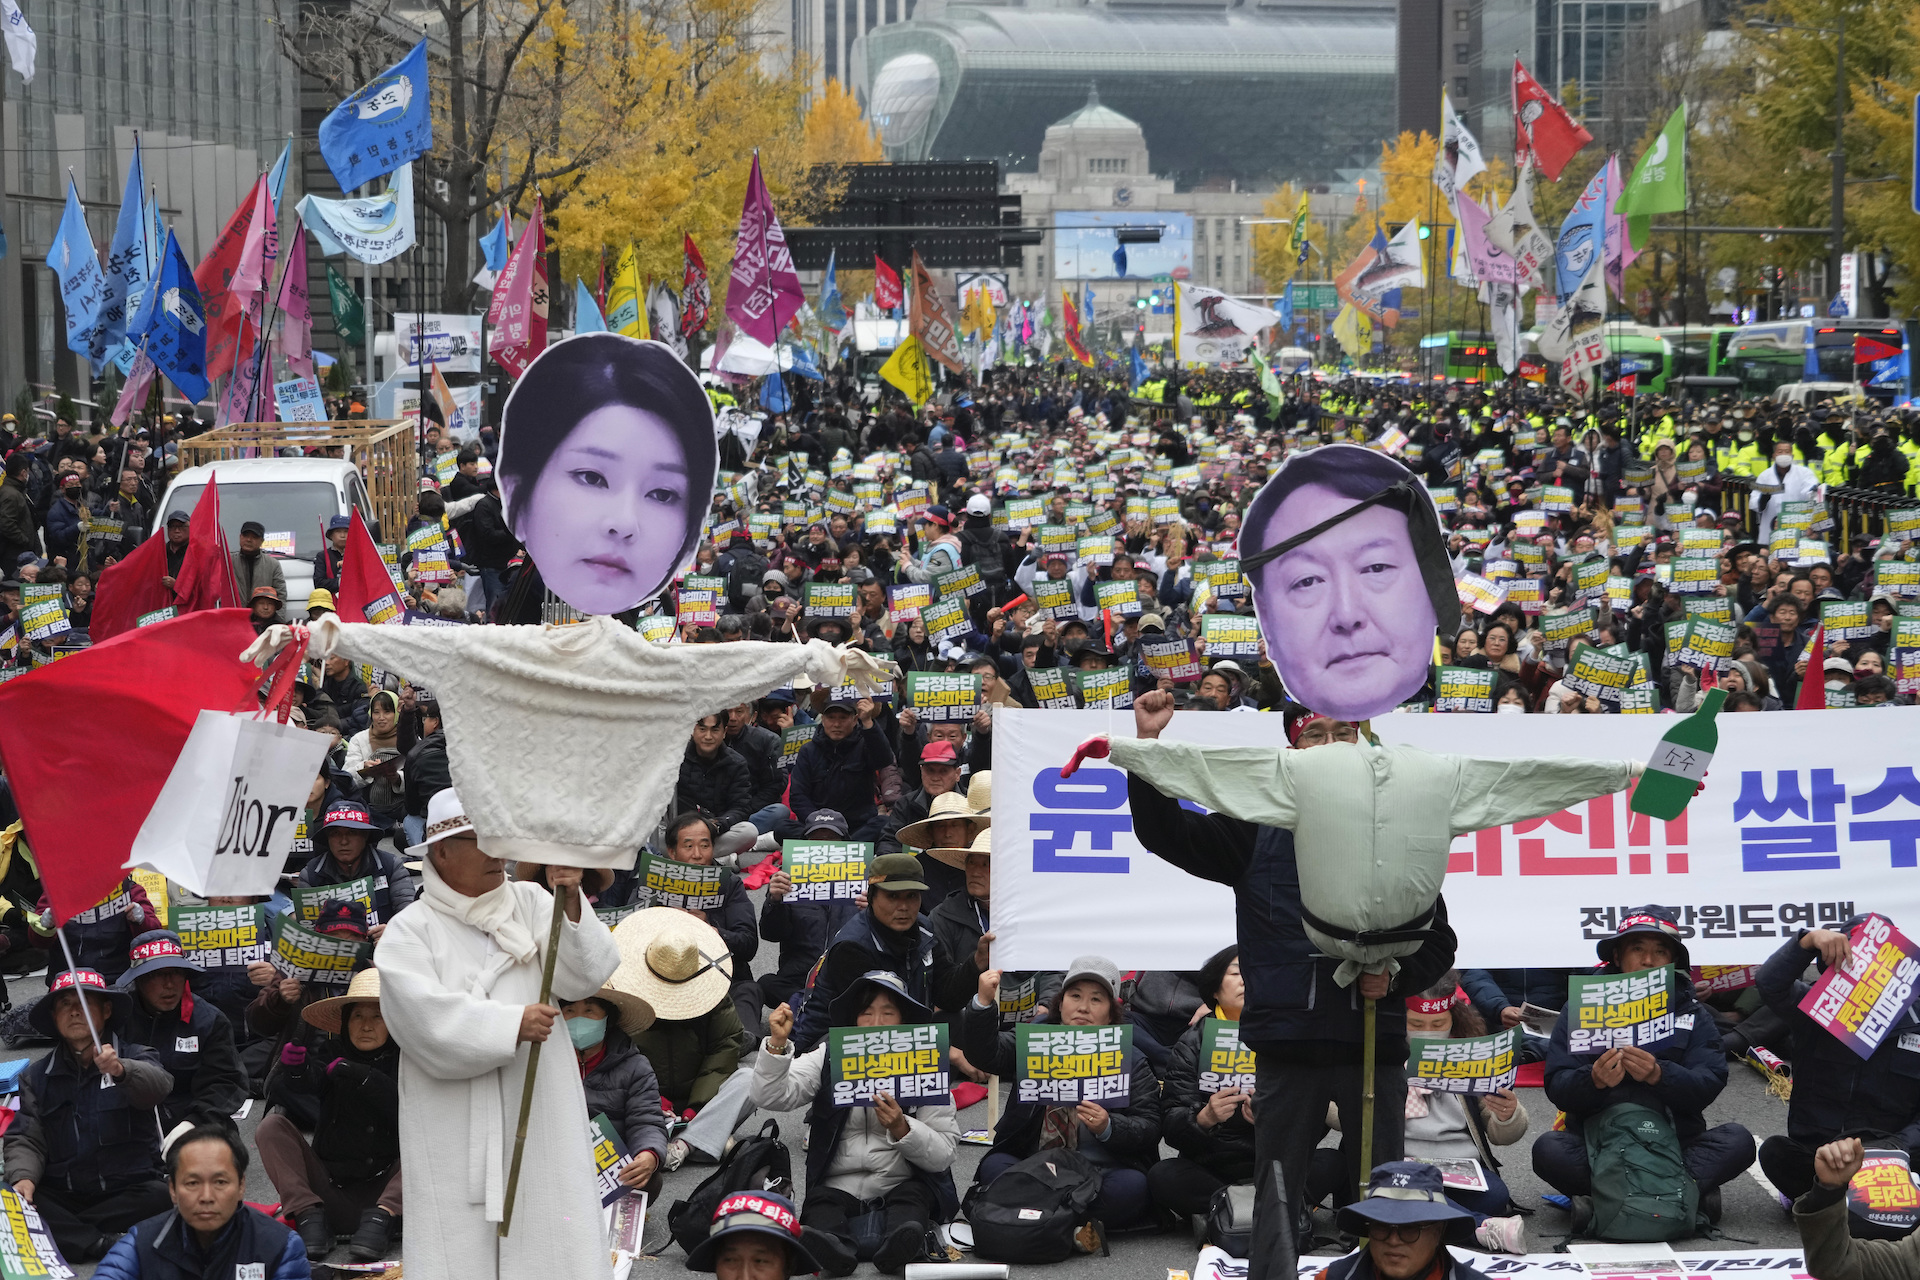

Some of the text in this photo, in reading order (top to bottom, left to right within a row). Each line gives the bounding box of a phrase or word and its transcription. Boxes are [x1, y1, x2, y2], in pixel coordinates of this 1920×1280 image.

[409, 523, 441, 545] 국정농단
[1079, 537, 1112, 549] 국정농단
[1682, 529, 1723, 542] 국정농단
[418, 551, 447, 562] 농업파괴
[1079, 545, 1113, 557] 민생파탄
[418, 560, 449, 572] 농민말살
[937, 565, 977, 585] 국정농단
[1485, 561, 1518, 573] 농업파괴
[1675, 558, 1719, 572] 국정농단
[688, 577, 724, 588] 국정농단
[940, 574, 980, 595] 민생파탄
[1461, 574, 1505, 597] 농업파괴
[1499, 579, 1540, 591] 농업파괴
[1669, 580, 1721, 593] 윤석열 퇴진!
[1674, 569, 1719, 583] 민생파탄
[25, 583, 63, 597] 국정농단
[679, 590, 713, 602] 농업파괴
[810, 585, 853, 597] 국정농단
[892, 584, 930, 600] 농업파괴
[965, 580, 987, 597] 퇴진!
[1034, 580, 1068, 595] 국정농단
[1098, 581, 1137, 599] 국정농단
[1219, 582, 1243, 596] 퇴진!
[1457, 580, 1500, 604] 농민말살
[22, 599, 60, 621] 국정농단
[679, 600, 712, 613] 농민말살
[804, 606, 857, 617] 윤석열 퇴진!
[809, 595, 853, 607] 민생파탄
[893, 595, 931, 611] 농민말살
[924, 599, 961, 622] 국정농단
[1099, 591, 1138, 611] 민생파탄
[1122, 599, 1142, 615] 퇴진!
[1520, 600, 1545, 611] 퇴진!
[1685, 598, 1730, 614] 국정농단
[1824, 602, 1867, 618] 국정농단
[23, 610, 64, 634] 민생파탄
[694, 611, 715, 623] 퇴진!
[890, 608, 919, 623] 윤석열
[926, 611, 965, 635] 민생파탄
[1054, 604, 1079, 621] 퇴진!
[1545, 610, 1592, 632] 국정농단
[1823, 614, 1868, 629] 민생파탄
[50, 619, 71, 635] 퇴진!
[948, 621, 972, 641] 퇴진!
[1208, 617, 1258, 630] 국정농단
[1545, 619, 1594, 642] 민생파탄
[1846, 625, 1872, 641] 퇴진!
[1206, 629, 1259, 644] 민생파탄
[1141, 639, 1188, 656] 농업파괴
[1172, 662, 1200, 678] 퇴진!
[1579, 650, 1635, 676] 국정농단
[915, 675, 976, 691] 국정농단
[1083, 667, 1130, 688] 국정농단
[1441, 671, 1493, 686] 국정농단
[1564, 673, 1602, 698] 윤석열
[1573, 663, 1630, 689] 민생파탄
[913, 690, 976, 707] 민생파탄
[1083, 679, 1130, 702] 민생파탄
[1440, 684, 1492, 700] 민생파탄
[279, 703, 290, 721] GEM
[950, 705, 981, 720] 퇴진!
[1436, 697, 1493, 713] 윤석열 퇴진!
[1663, 745, 1697, 772] 소주
[215, 775, 298, 858] Dior
[791, 843, 867, 864] 국정농단
[649, 859, 723, 883] 국정농단
[790, 862, 867, 884] 민생파탄
[646, 873, 721, 896] 민생파탄
[783, 882, 831, 903] 윤석열
[98, 890, 132, 921] 퇴진!
[637, 886, 726, 910] 윤석열 퇴진!
[178, 906, 257, 932] 국정농단
[177, 926, 258, 951] 민생파탄
[280, 923, 361, 957] 국정농단
[1842, 915, 1891, 983] 윤석열
[187, 944, 265, 968] 석열 퇴진!
[277, 937, 357, 971] 민생파탄
[1580, 967, 1668, 1006] 국정농단
[1834, 941, 1907, 1034] 농민말살
[1808, 973, 1855, 1028] 퇴진!
[1854, 956, 1920, 1051] 농업파괴
[1579, 994, 1670, 1029] 민생파탄
[842, 1026, 939, 1055] 국정농단
[1027, 1026, 1122, 1056] 국정농단
[1569, 1012, 1676, 1053] 윤석열 퇴진!
[1421, 1031, 1515, 1062] 국정농단
[841, 1049, 940, 1081] 민생파탄
[1026, 1050, 1123, 1080] 민생파탄
[1417, 1050, 1515, 1079] 민생파탄
[832, 1071, 949, 1105] 윤석열 퇴진!
[1018, 1073, 1130, 1102] 윤석열 퇴진!
[1407, 1065, 1519, 1095] 윤석열 퇴진!
[1851, 1165, 1911, 1189] 윤석열
[1867, 1184, 1918, 1209] 퇴진!
[0, 1188, 49, 1276] 민생파탄
